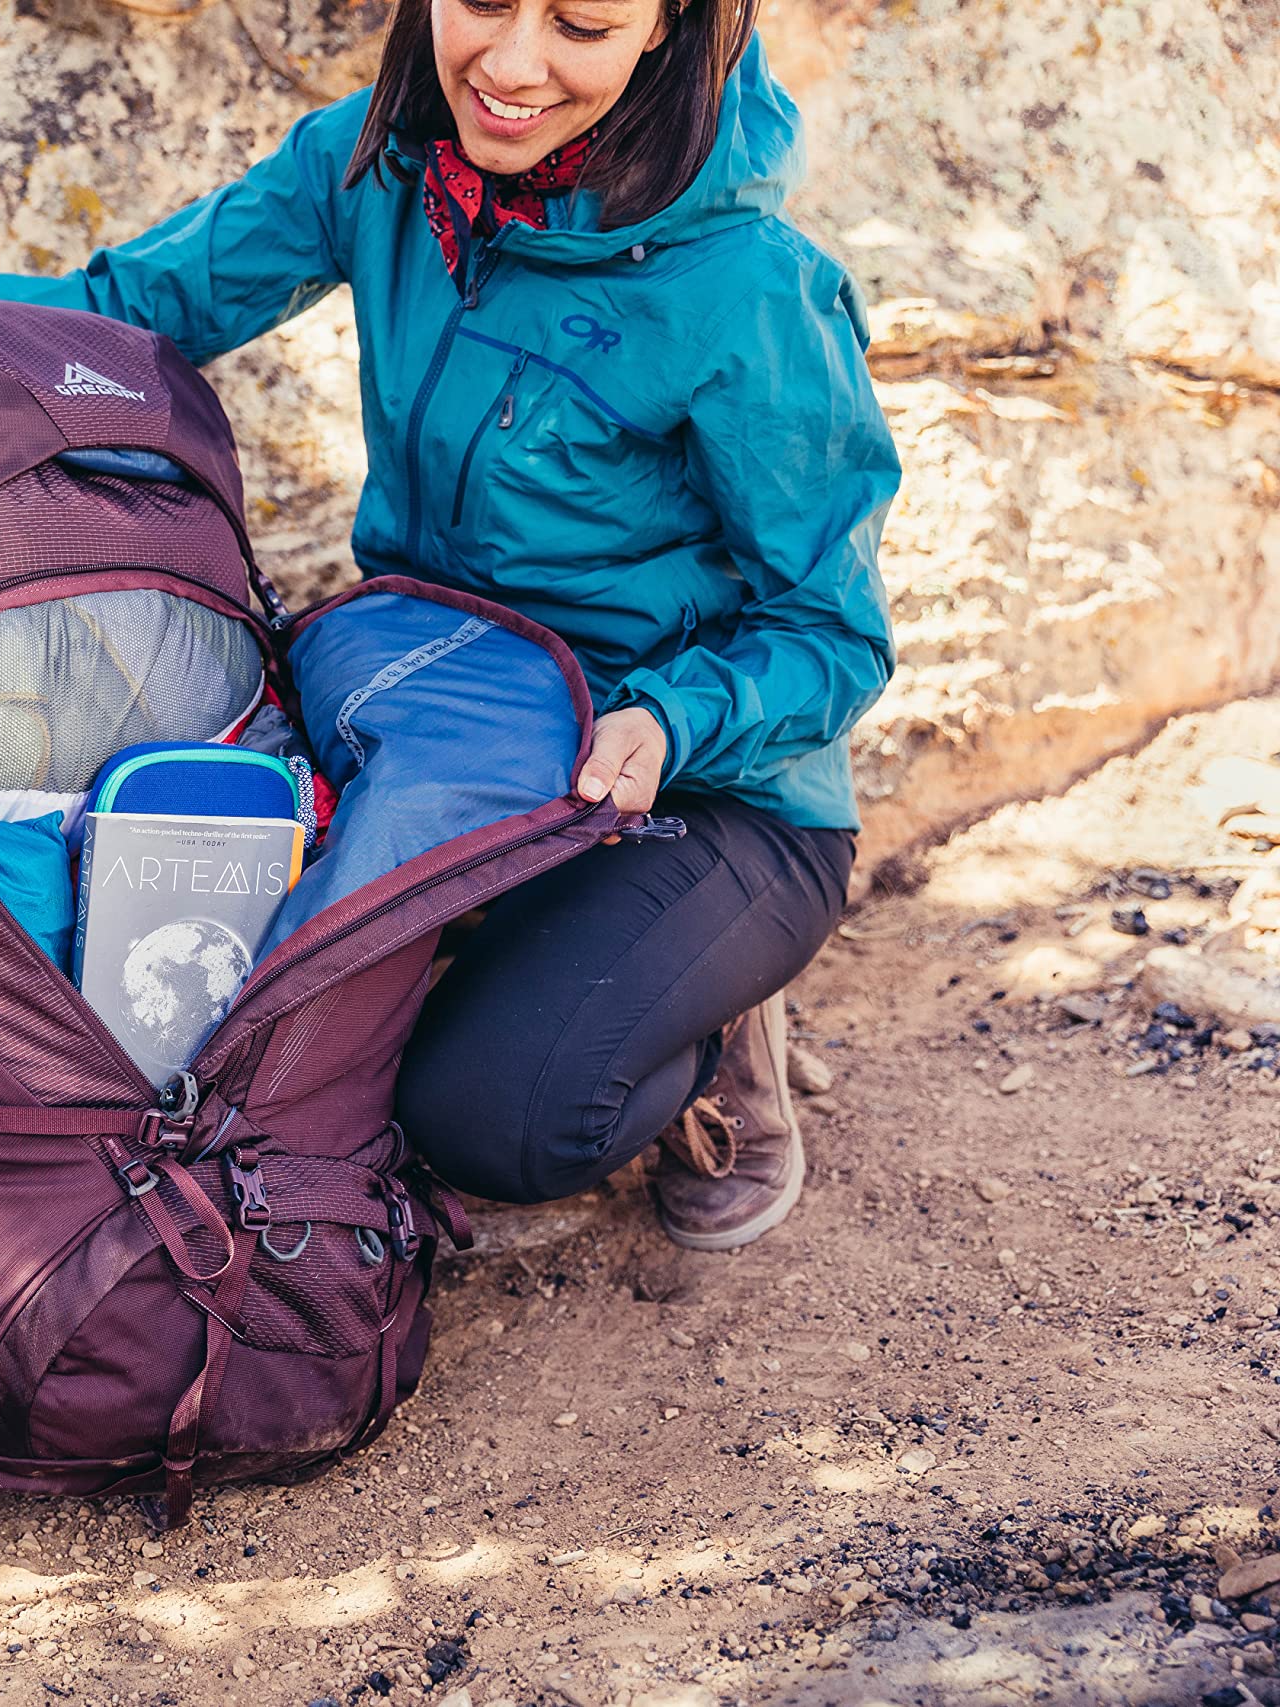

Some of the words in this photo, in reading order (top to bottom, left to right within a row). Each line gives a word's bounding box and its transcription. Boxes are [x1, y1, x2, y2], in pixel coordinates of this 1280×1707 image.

[560, 314, 621, 354] OR
[54, 383, 146, 401] GREGORY
[231, 831, 240, 839] the
[76, 826, 94, 948] ARTEMIS
[102, 856, 284, 896] ARTEMIS
